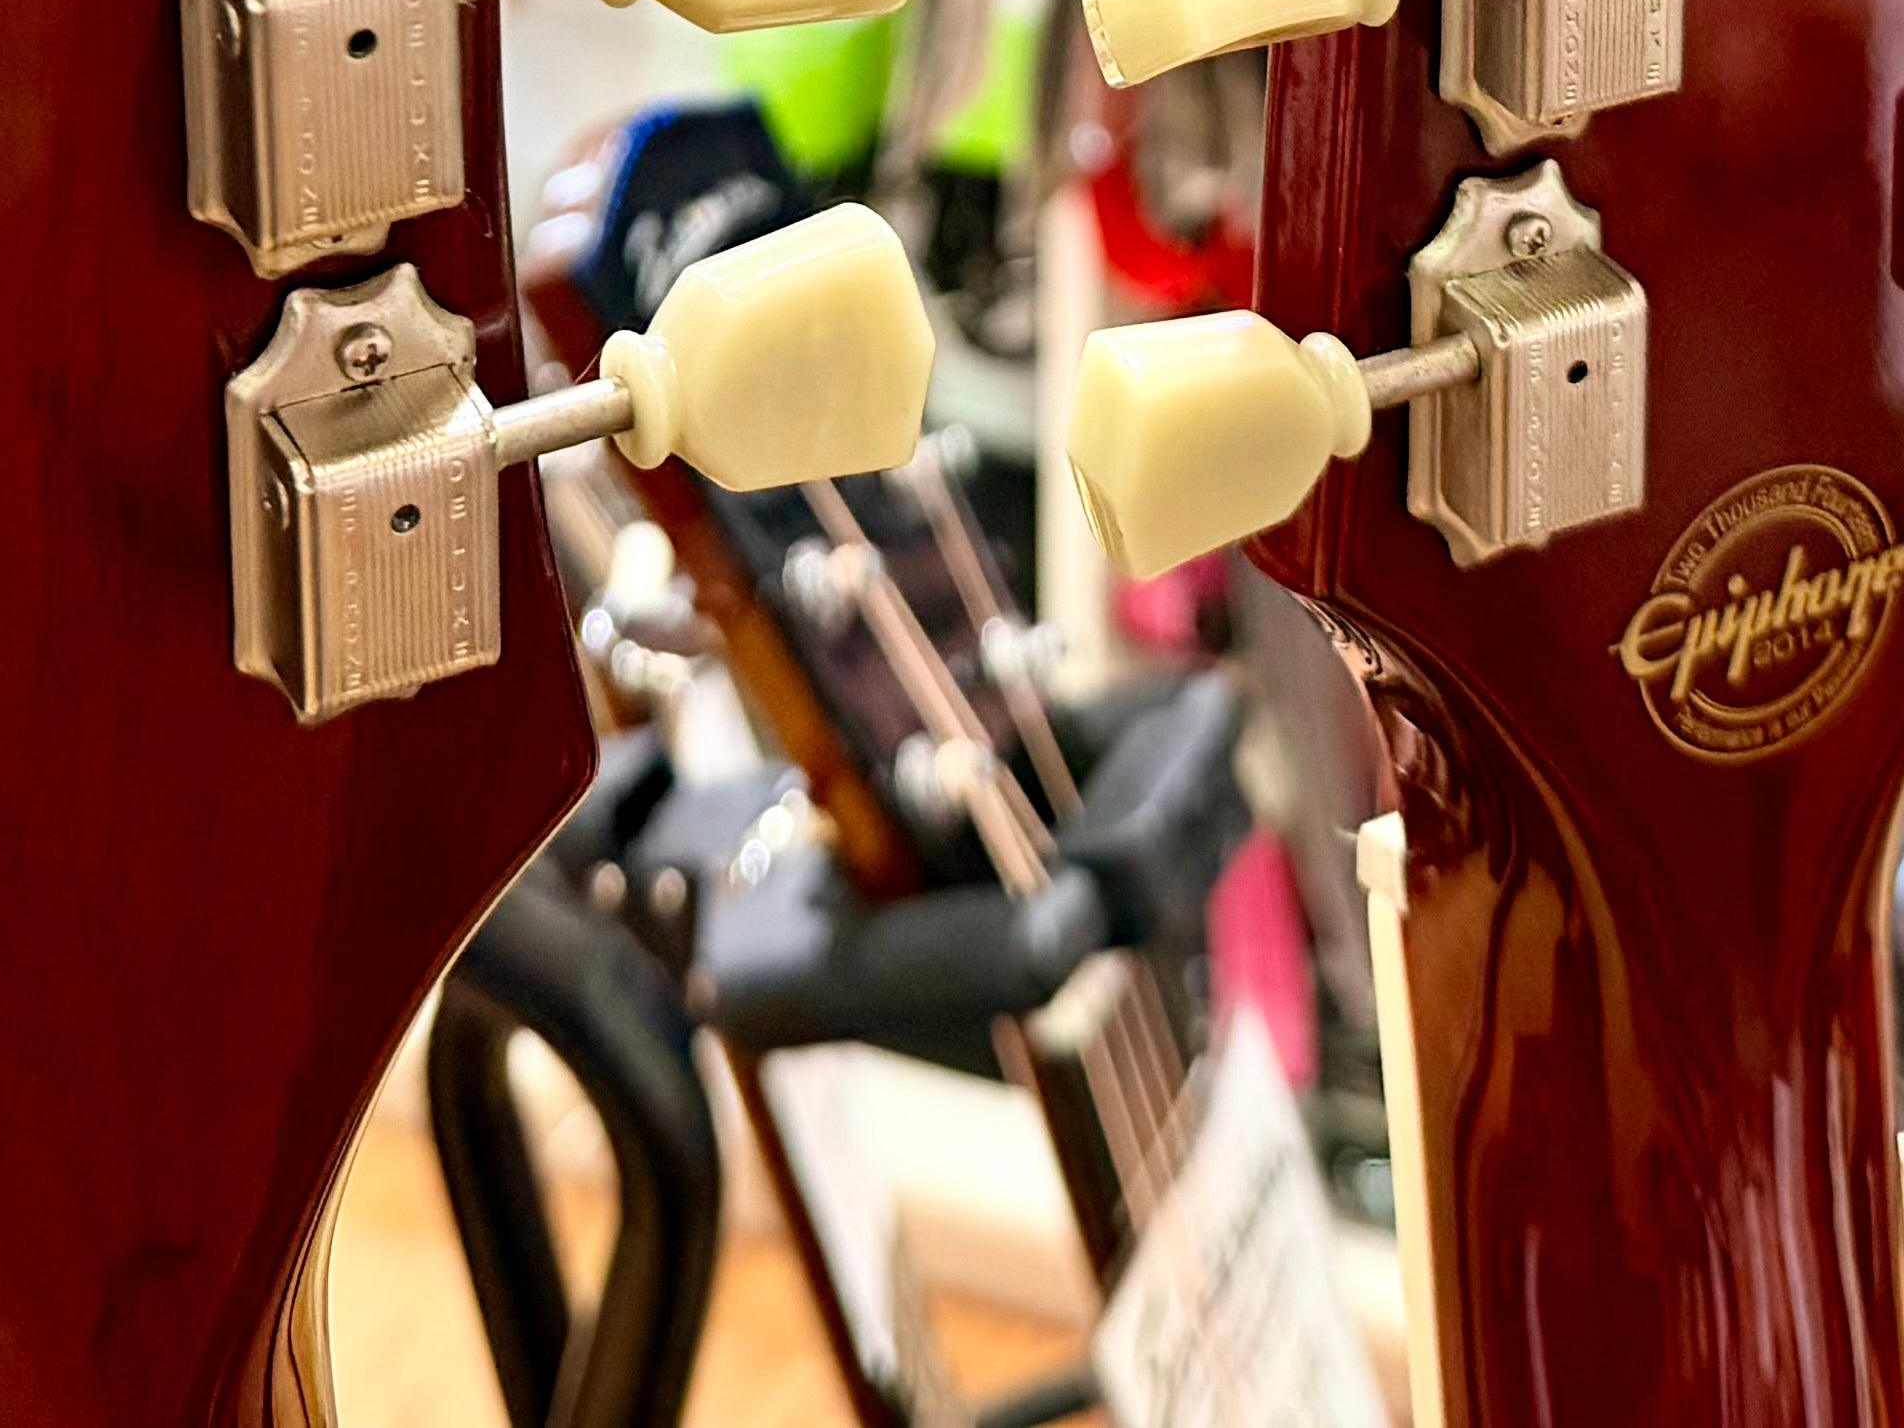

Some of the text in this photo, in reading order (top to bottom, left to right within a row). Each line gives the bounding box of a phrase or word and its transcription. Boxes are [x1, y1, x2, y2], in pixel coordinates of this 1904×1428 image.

[292, 13, 320, 229] EPPHONE
[339, 488, 362, 689] EPIPHONE
[449, 459, 472, 663] DELUXE
[1662, 475, 1881, 587] Two Thousand Four
[1753, 618, 1835, 668] 2014
